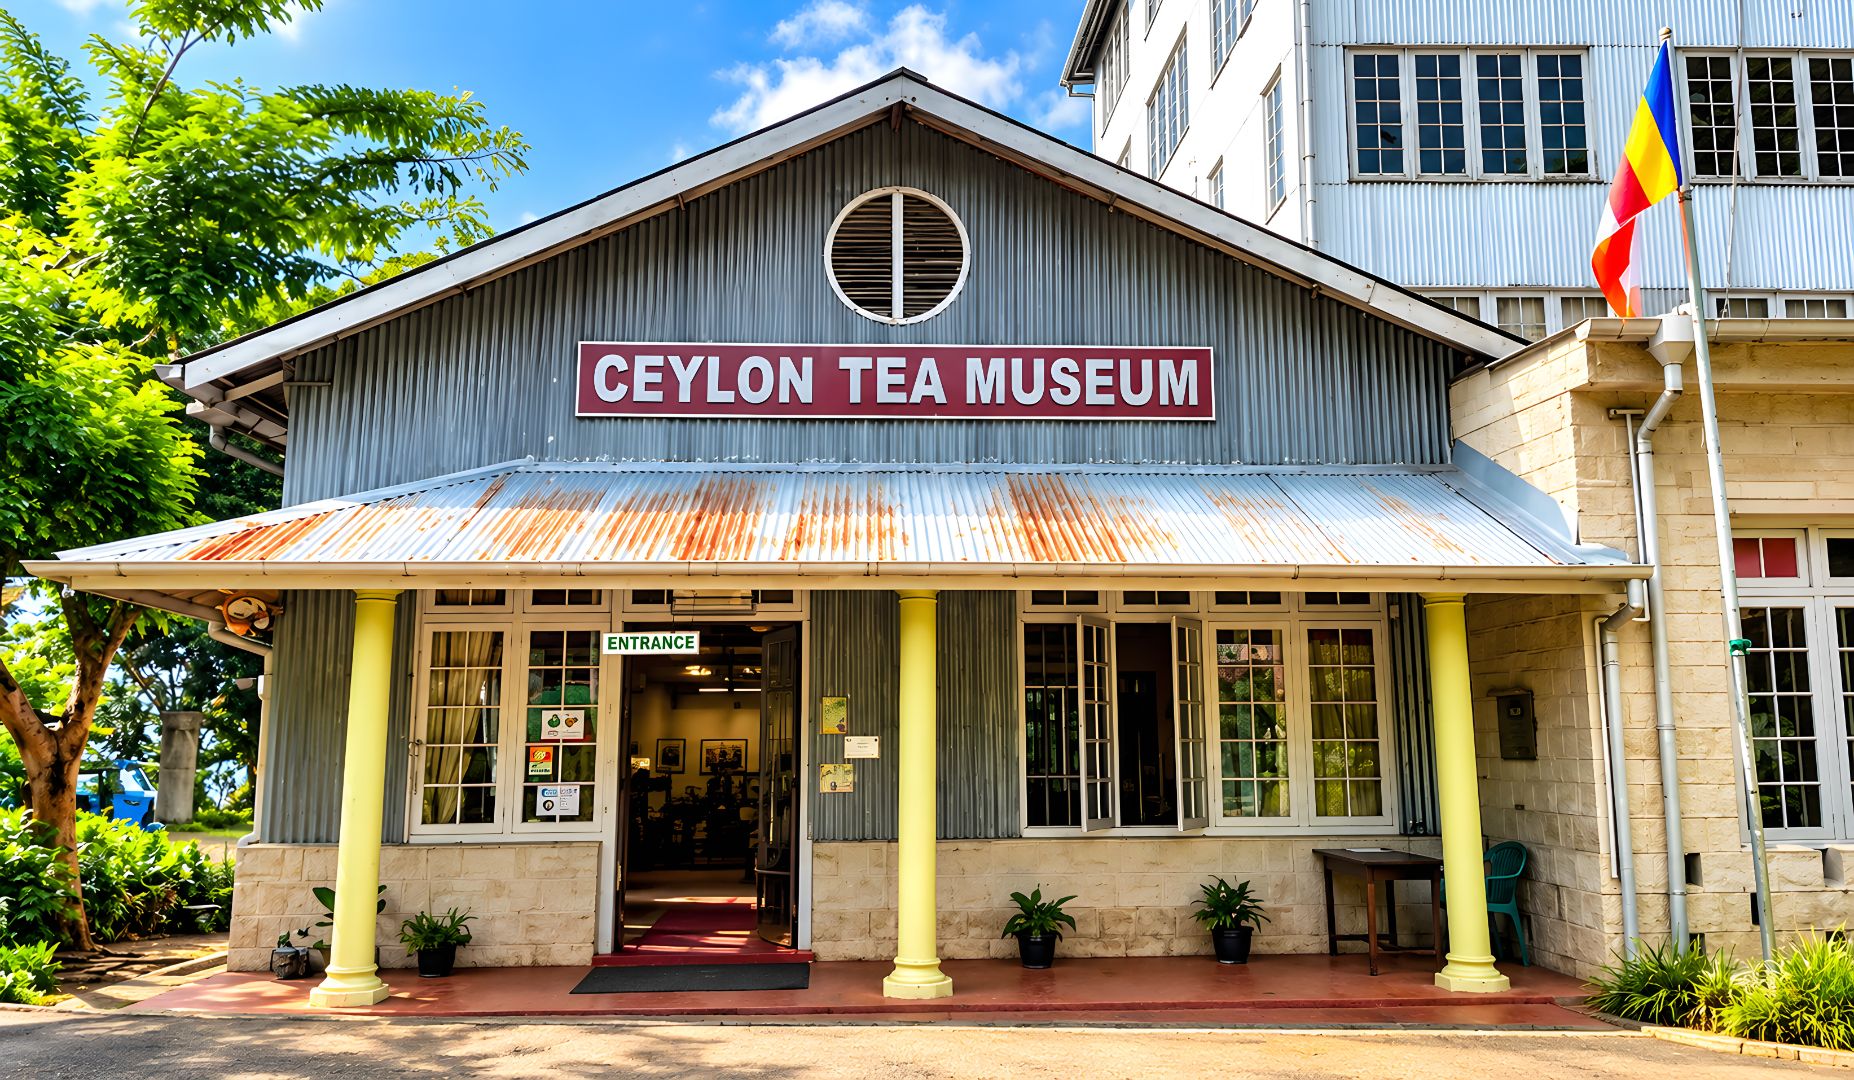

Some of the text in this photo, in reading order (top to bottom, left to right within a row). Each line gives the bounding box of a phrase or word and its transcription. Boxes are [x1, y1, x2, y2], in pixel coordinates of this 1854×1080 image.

[593, 354, 1199, 406] CEYLON TEA MUSEUM
[607, 635, 695, 650] ENTRANCE
